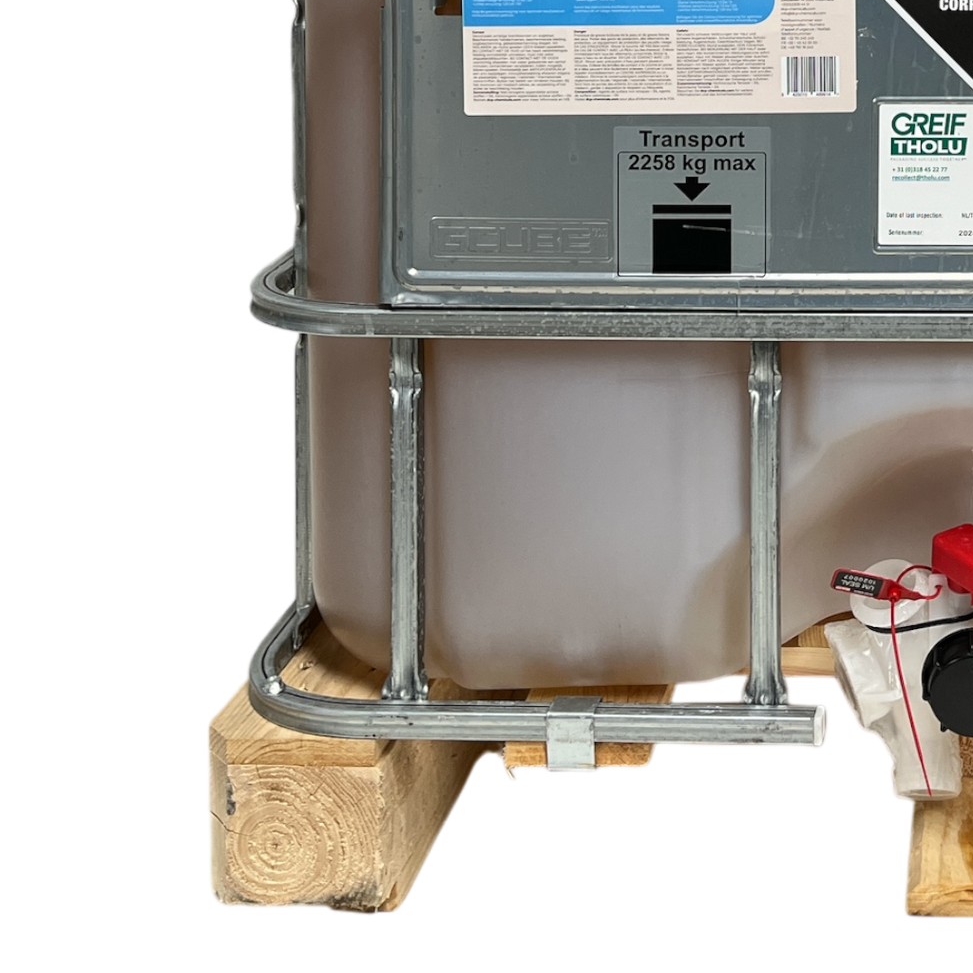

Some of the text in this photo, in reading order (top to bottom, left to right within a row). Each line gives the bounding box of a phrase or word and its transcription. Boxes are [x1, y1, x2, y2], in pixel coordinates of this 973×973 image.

[892, 112, 967, 135] GREIF
[639, 130, 745, 151] Transport
[894, 140, 962, 154] THOLU
[628, 154, 756, 175] 2258 kg max
